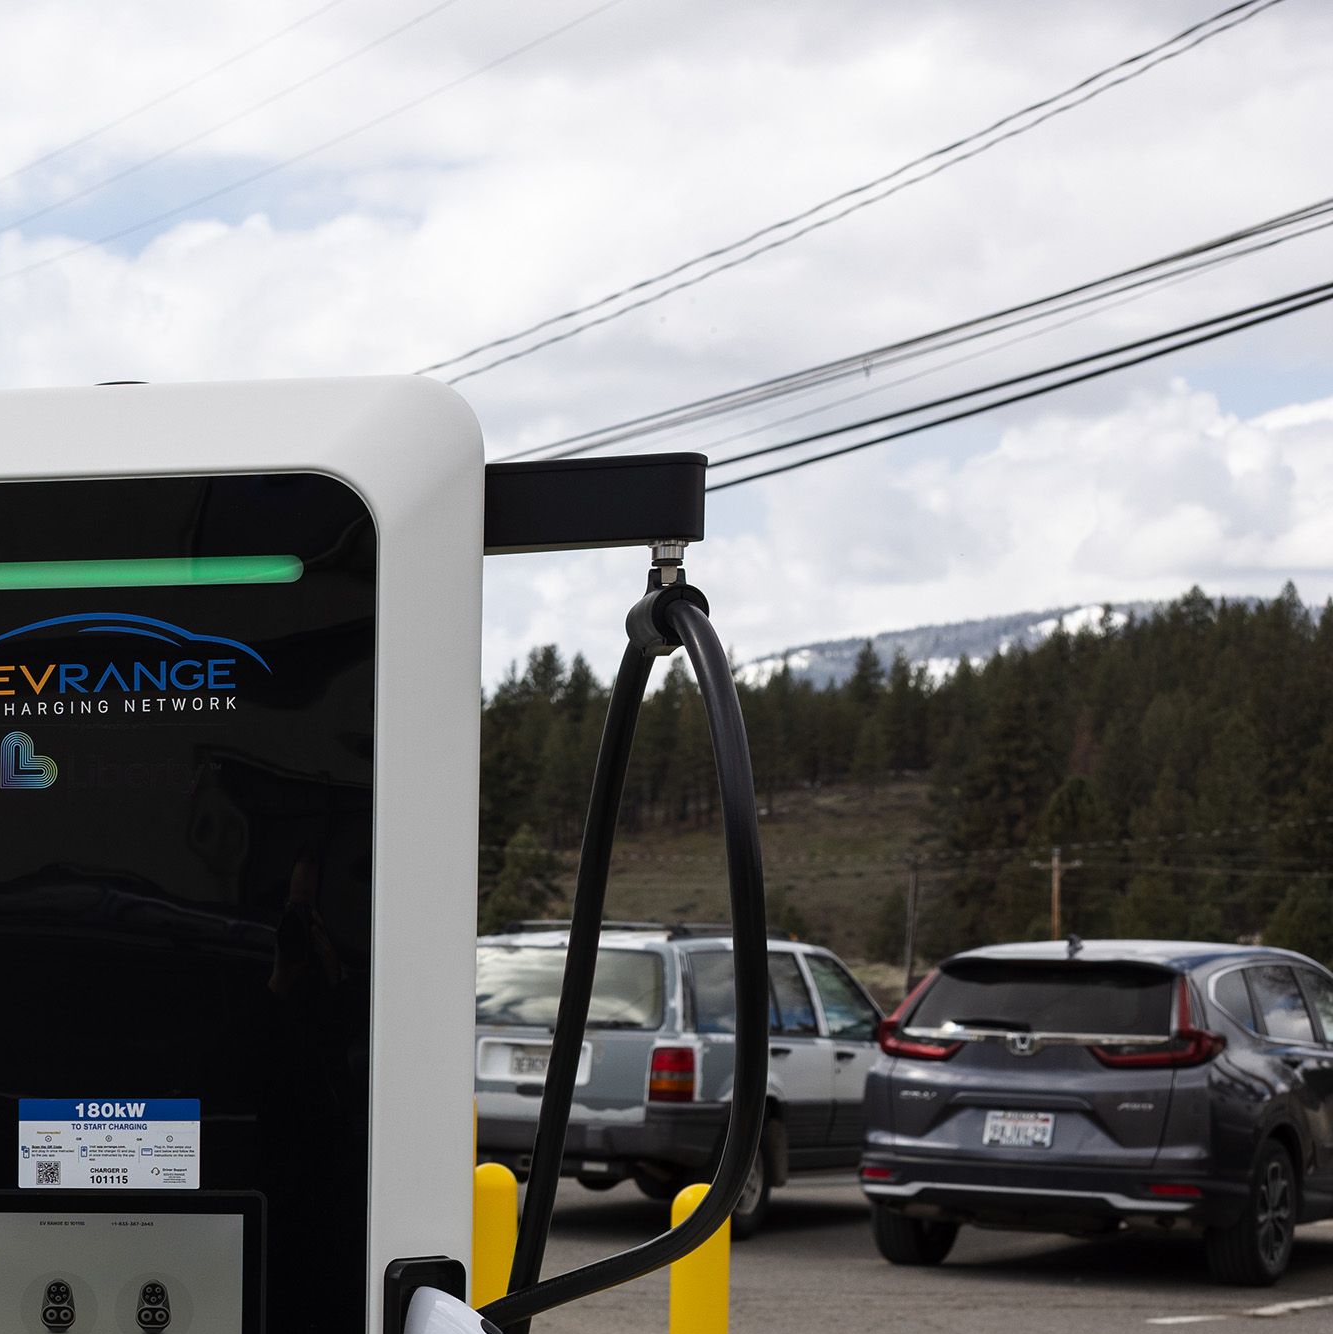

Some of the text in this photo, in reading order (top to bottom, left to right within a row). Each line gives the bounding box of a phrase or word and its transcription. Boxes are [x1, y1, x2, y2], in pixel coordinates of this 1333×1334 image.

[124, 696, 237, 714] NETWORK
[75, 1102, 146, 1118] 180kW
[71, 1123, 148, 1131] TO START CHARGING
[90, 1175, 128, 1185] 101115
